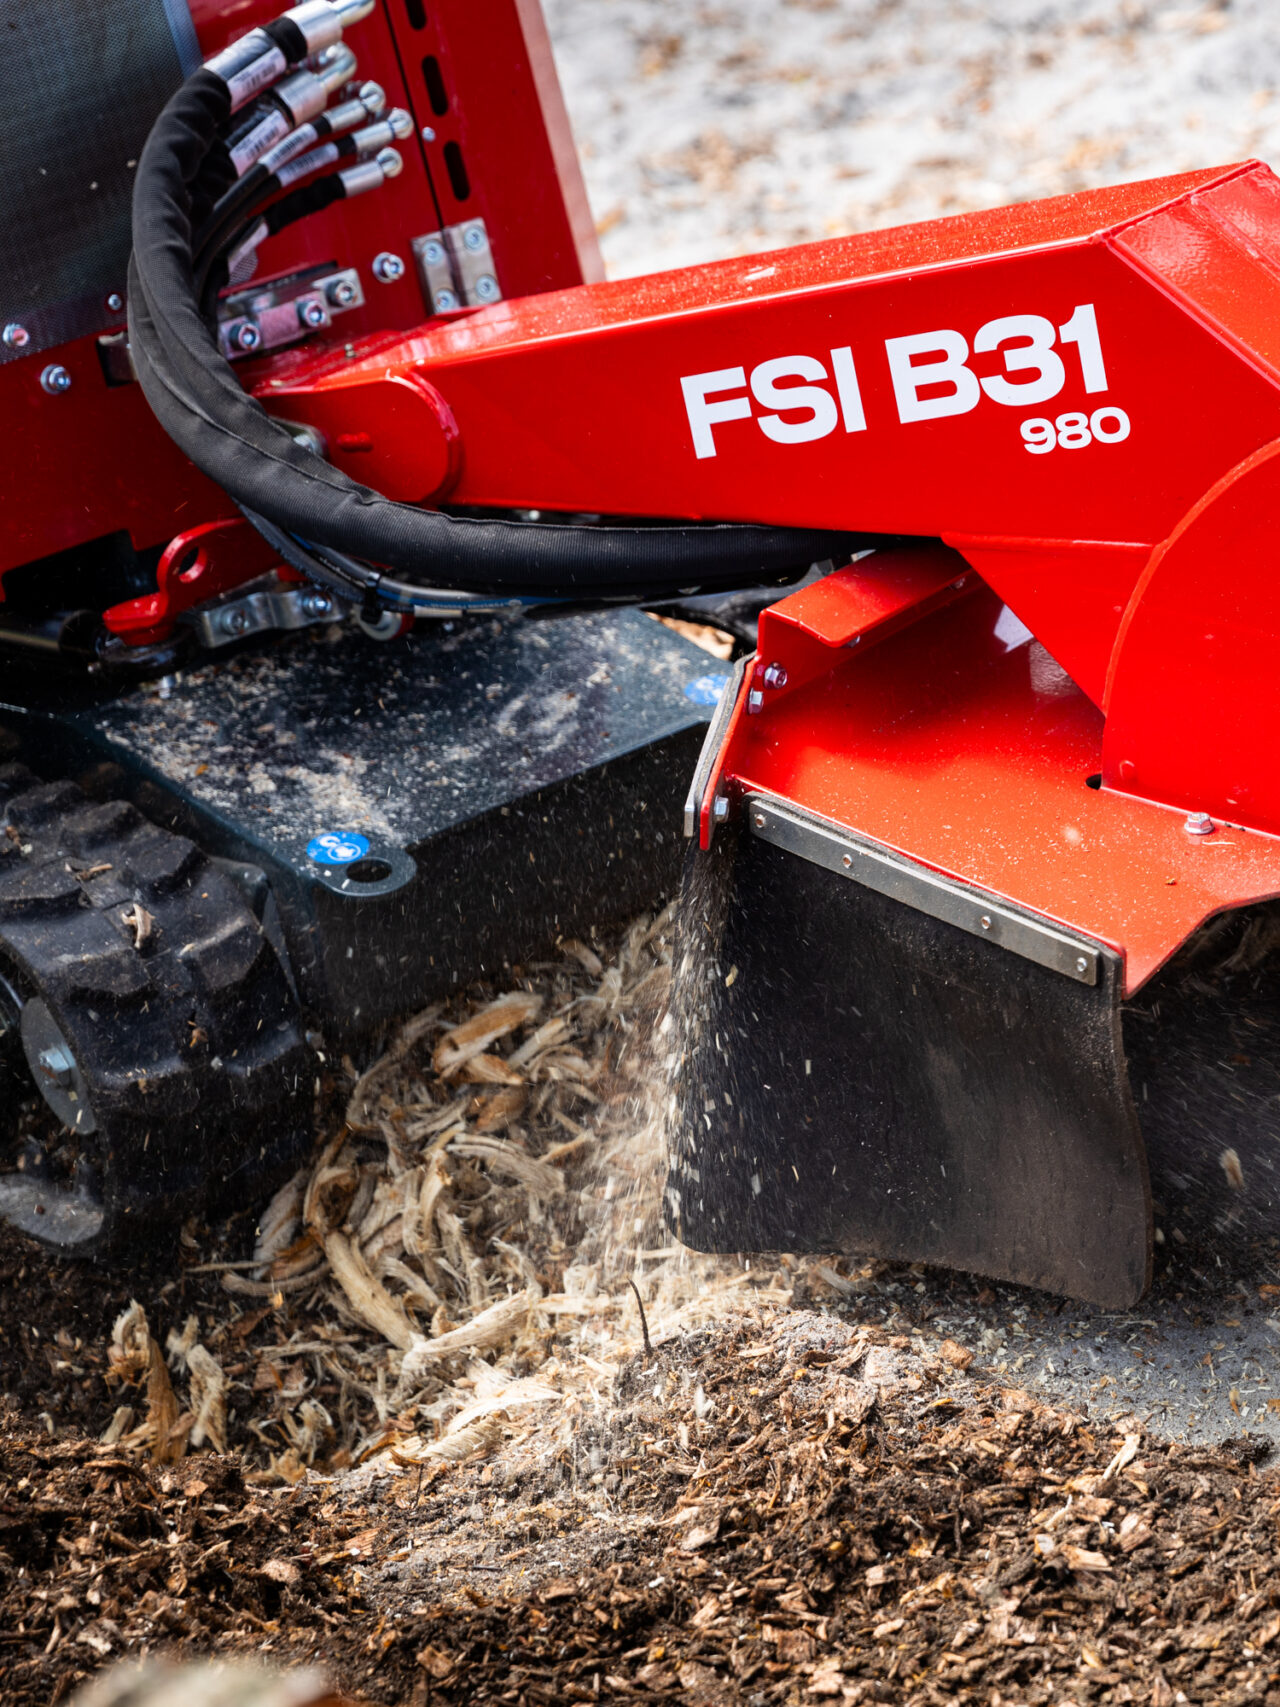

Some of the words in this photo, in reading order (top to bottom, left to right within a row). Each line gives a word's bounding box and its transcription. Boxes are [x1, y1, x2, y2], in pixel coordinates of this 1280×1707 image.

[680, 347, 867, 459] FSI
[885, 304, 1108, 424] B31
[1020, 407, 1130, 454] 980
